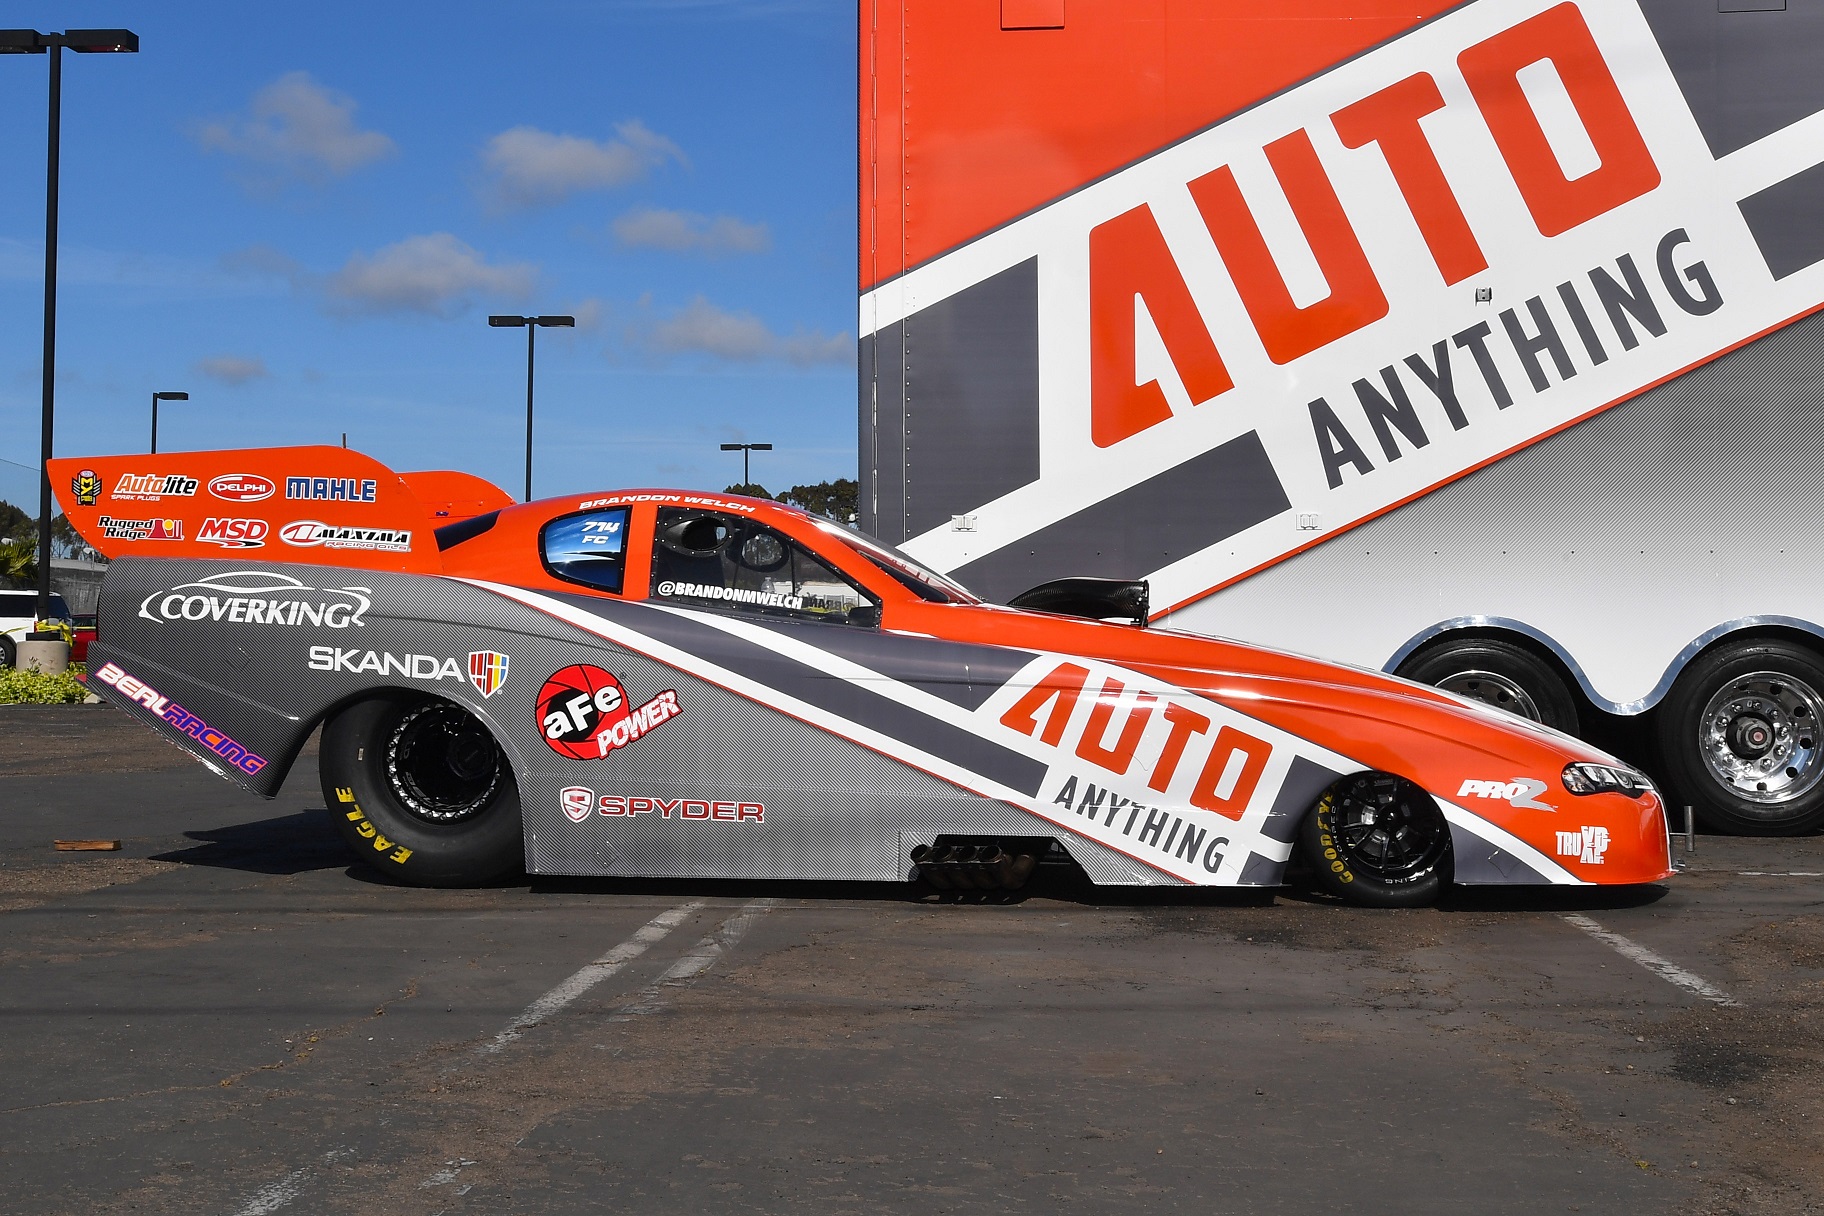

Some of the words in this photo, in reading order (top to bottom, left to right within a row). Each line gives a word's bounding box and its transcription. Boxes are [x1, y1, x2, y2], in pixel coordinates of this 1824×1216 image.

[1089, 1, 1661, 448] AUTO
[1309, 228, 1724, 489] ANYTHING
[114, 473, 199, 495] Autolite
[216, 483, 266, 492] DELPHI
[286, 477, 376, 502] MAHLE
[579, 494, 681, 510] BRANDON
[684, 496, 756, 513] WELCH
[98, 516, 154, 529] Rugged
[104, 527, 147, 540] Ridge
[199, 518, 268, 540] MSD
[315, 528, 410, 544] MAXIMA
[581, 521, 620, 533] 714
[326, 541, 374, 549] RACING
[582, 535, 609, 545] FC
[657, 580, 803, 610] @BRANDONMWELCH
[160, 594, 353, 629] COVERKING
[308, 645, 466, 683] SKANDA
[543, 685, 622, 740] aFe
[597, 689, 680, 758] POWER
[1000, 661, 1273, 821] AUTO
[598, 795, 765, 824] SPYDER
[335, 786, 414, 865] EAGLE
[1052, 775, 1230, 873] ANYTHING
